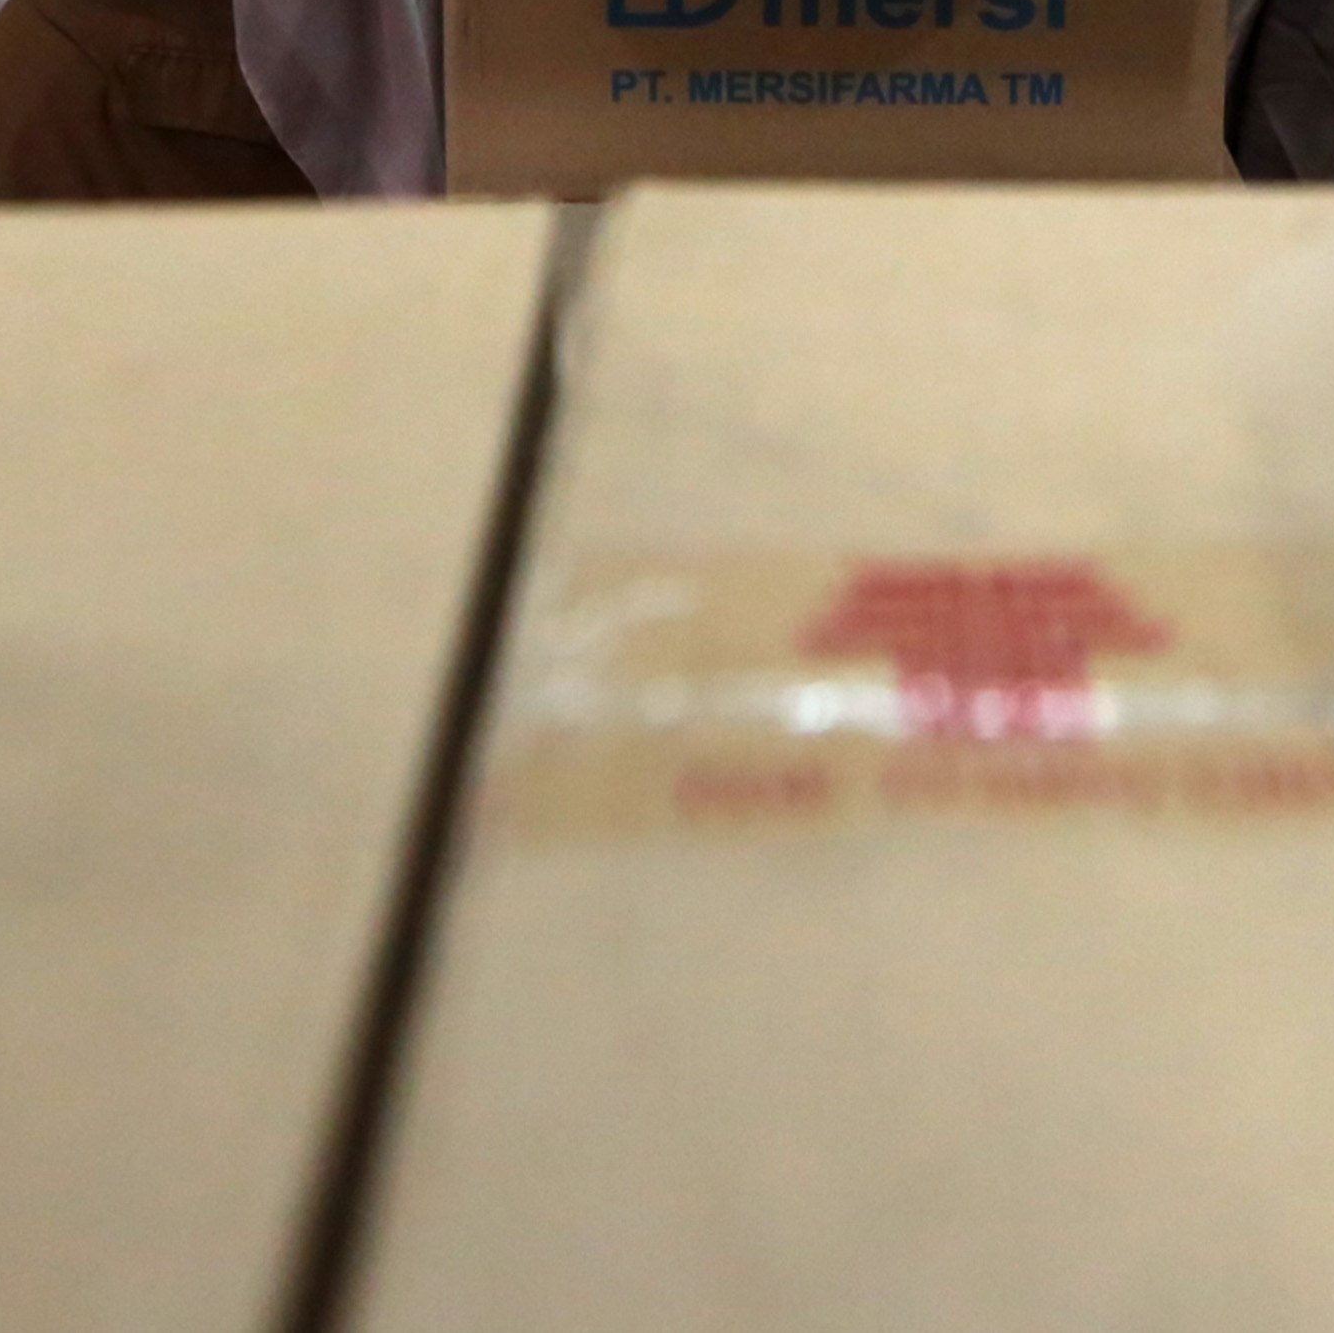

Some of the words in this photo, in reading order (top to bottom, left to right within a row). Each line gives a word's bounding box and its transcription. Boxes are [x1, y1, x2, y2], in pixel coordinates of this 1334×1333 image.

[611, 70, 672, 102] PT.
[689, 71, 990, 105] MERSIFARMA
[1001, 72, 1064, 105] TM
